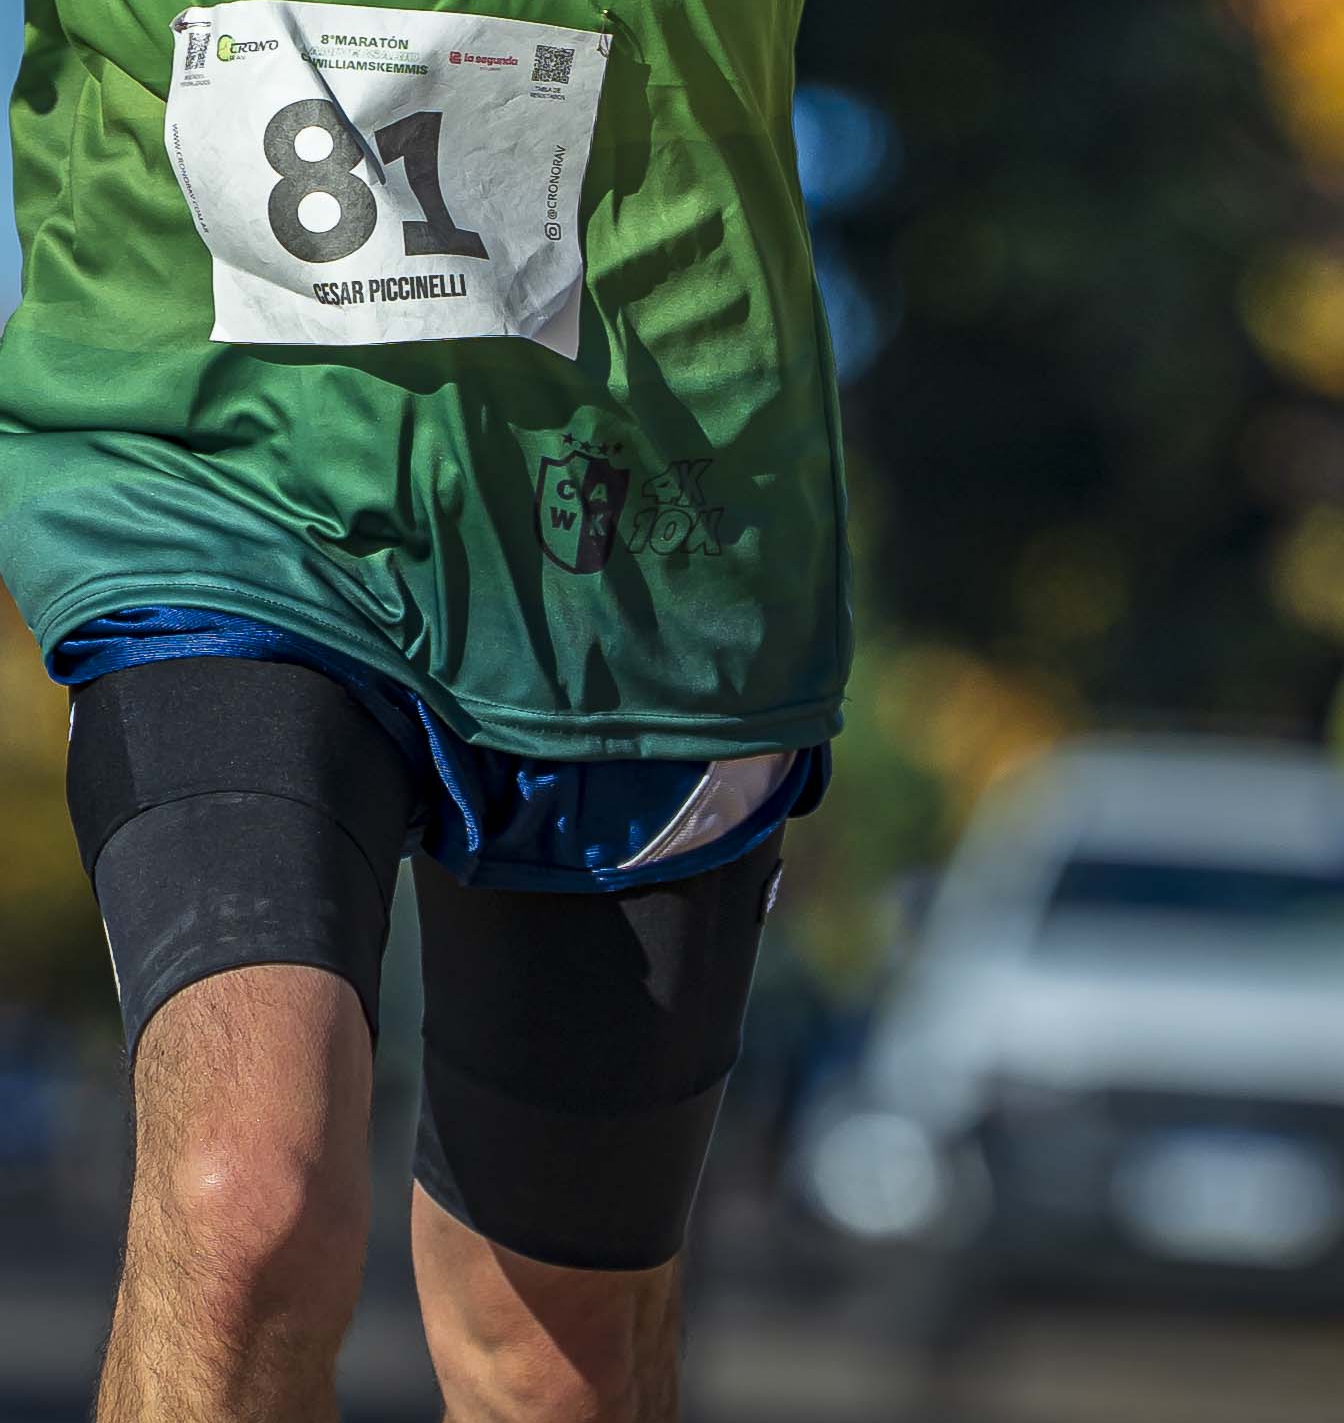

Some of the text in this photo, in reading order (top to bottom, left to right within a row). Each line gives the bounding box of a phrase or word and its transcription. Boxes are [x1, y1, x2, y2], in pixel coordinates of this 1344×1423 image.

[263, 98, 490, 264] 81
[547, 144, 566, 220] @CRONORAV
[312, 273, 467, 306] CESAR PICCINELLI
